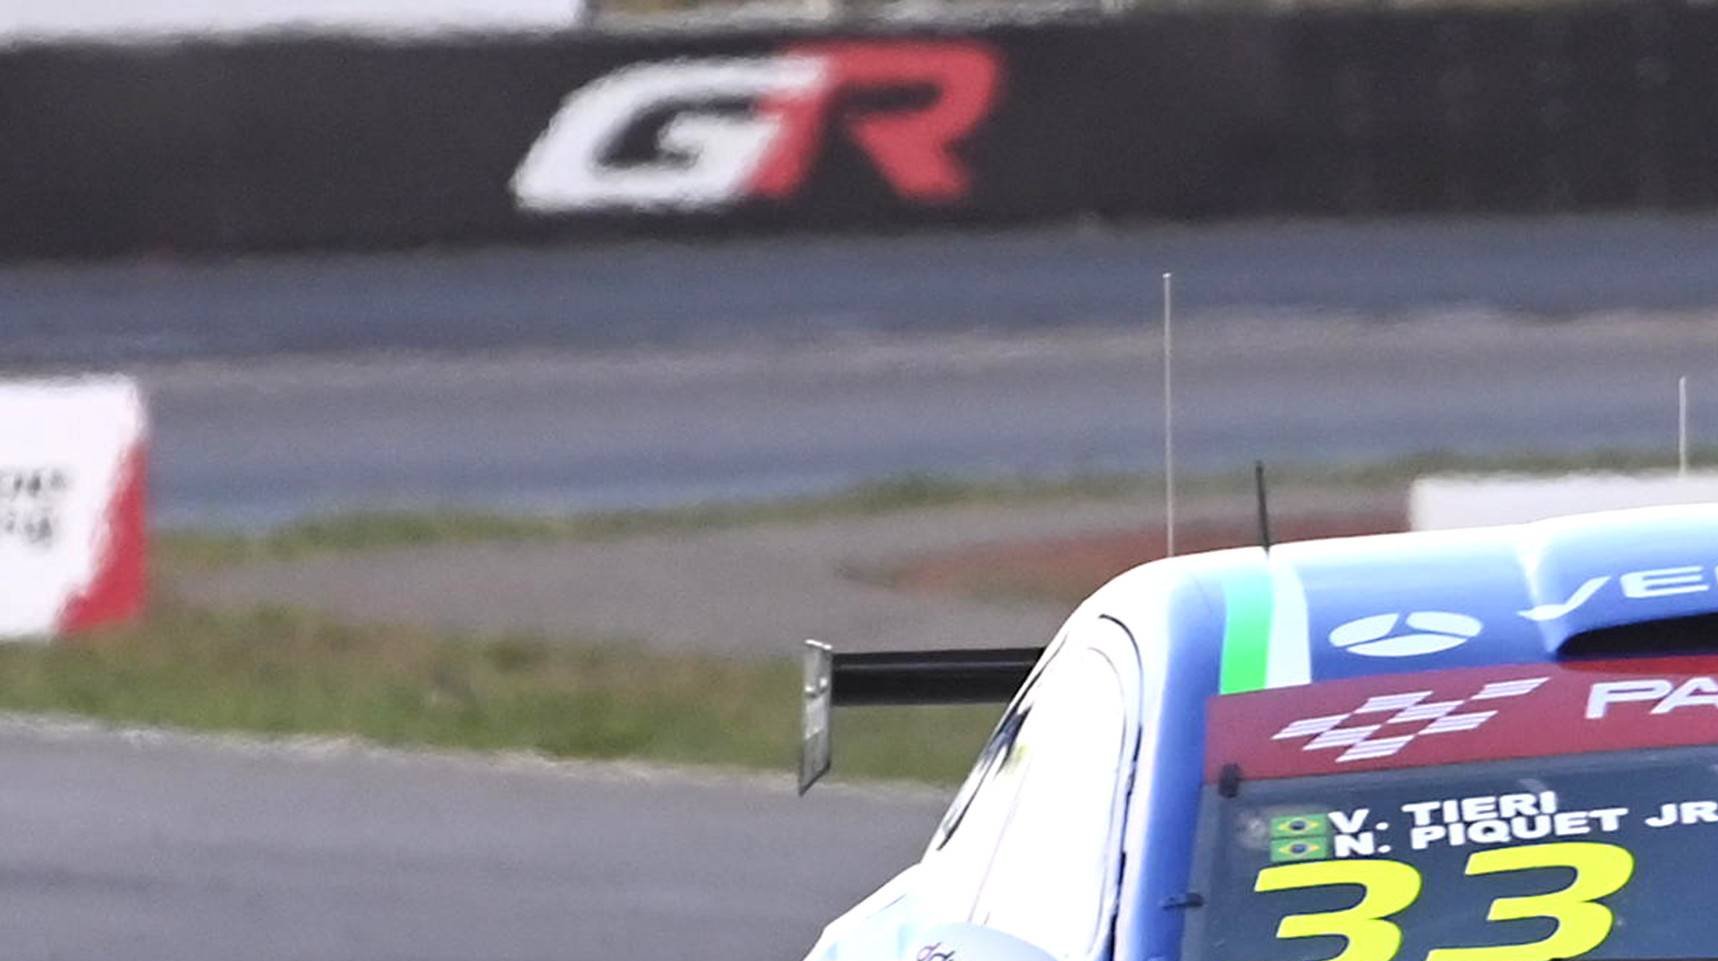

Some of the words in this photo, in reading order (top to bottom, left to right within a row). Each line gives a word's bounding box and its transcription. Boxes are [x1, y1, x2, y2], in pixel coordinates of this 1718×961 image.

[509, 38, 1000, 213] GR
[1334, 831, 1391, 858] N.
[1411, 807, 1629, 850] PIQUET
[1402, 790, 1558, 827] TIERI
